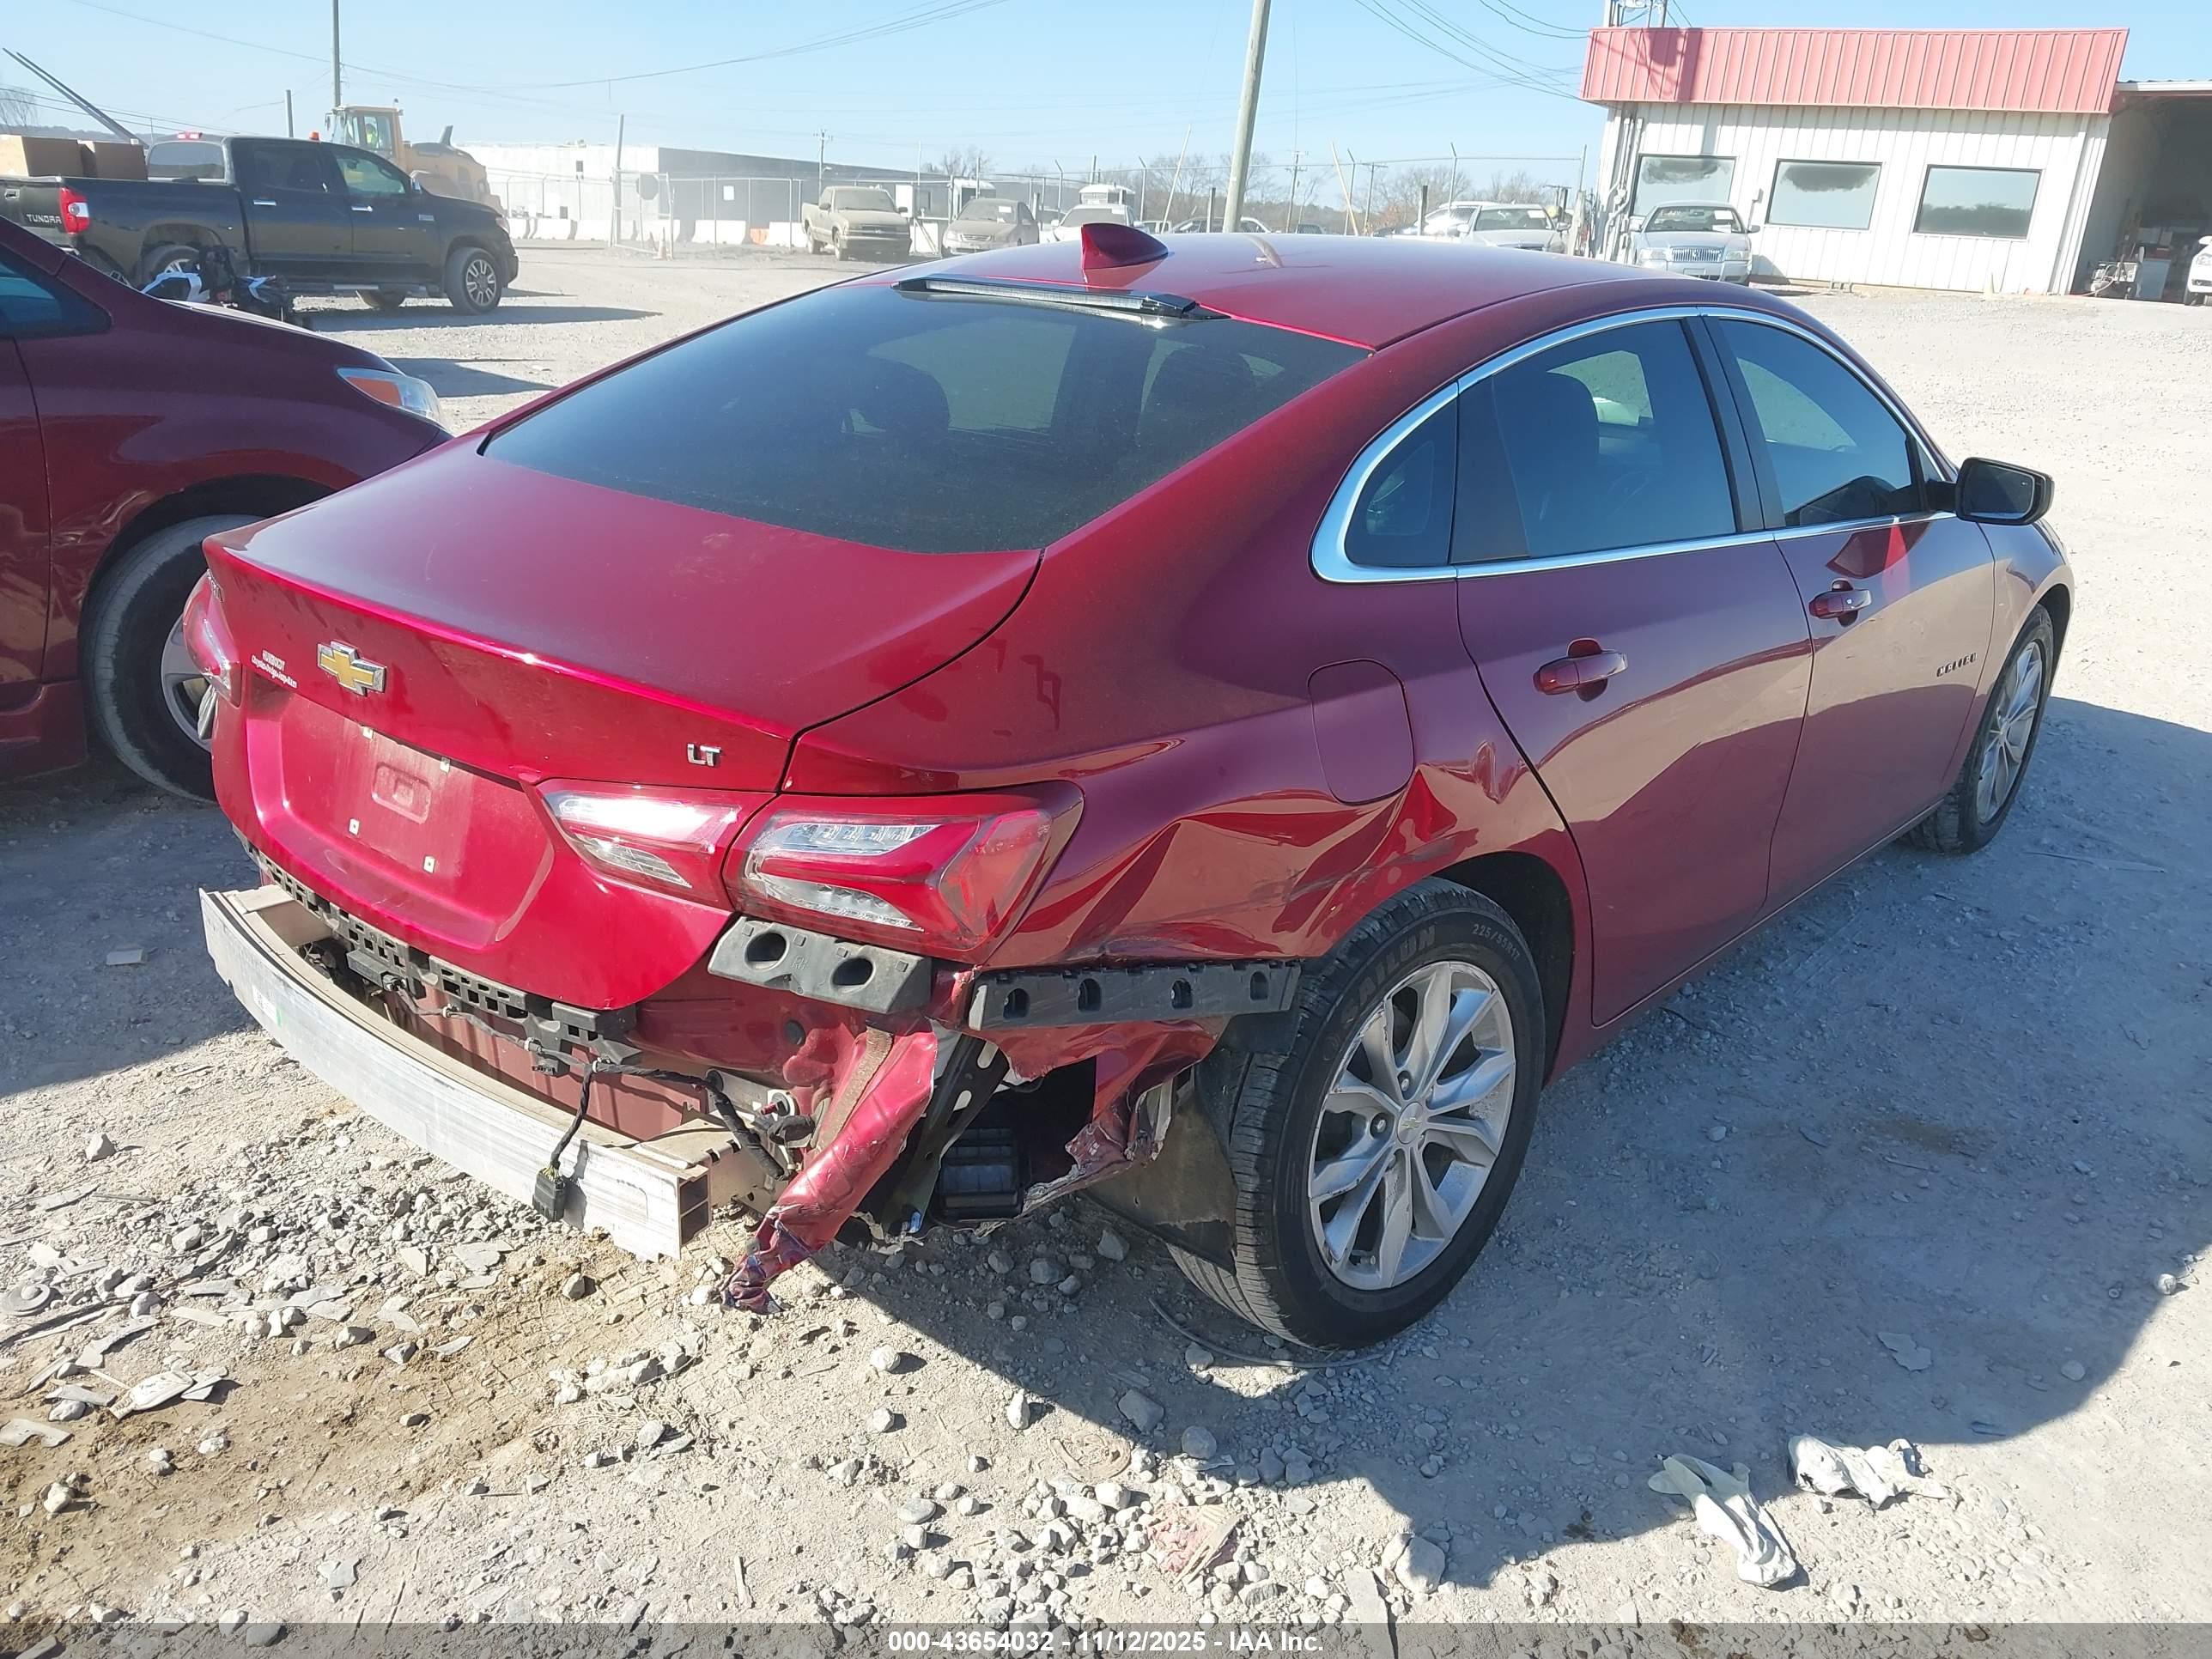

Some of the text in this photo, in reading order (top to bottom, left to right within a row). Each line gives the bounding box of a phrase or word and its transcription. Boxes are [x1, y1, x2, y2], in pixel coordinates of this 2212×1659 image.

[26, 214, 63, 224] TUNDRA
[687, 743, 722, 767] LT
[1471, 922, 1521, 962] 225/55R17
